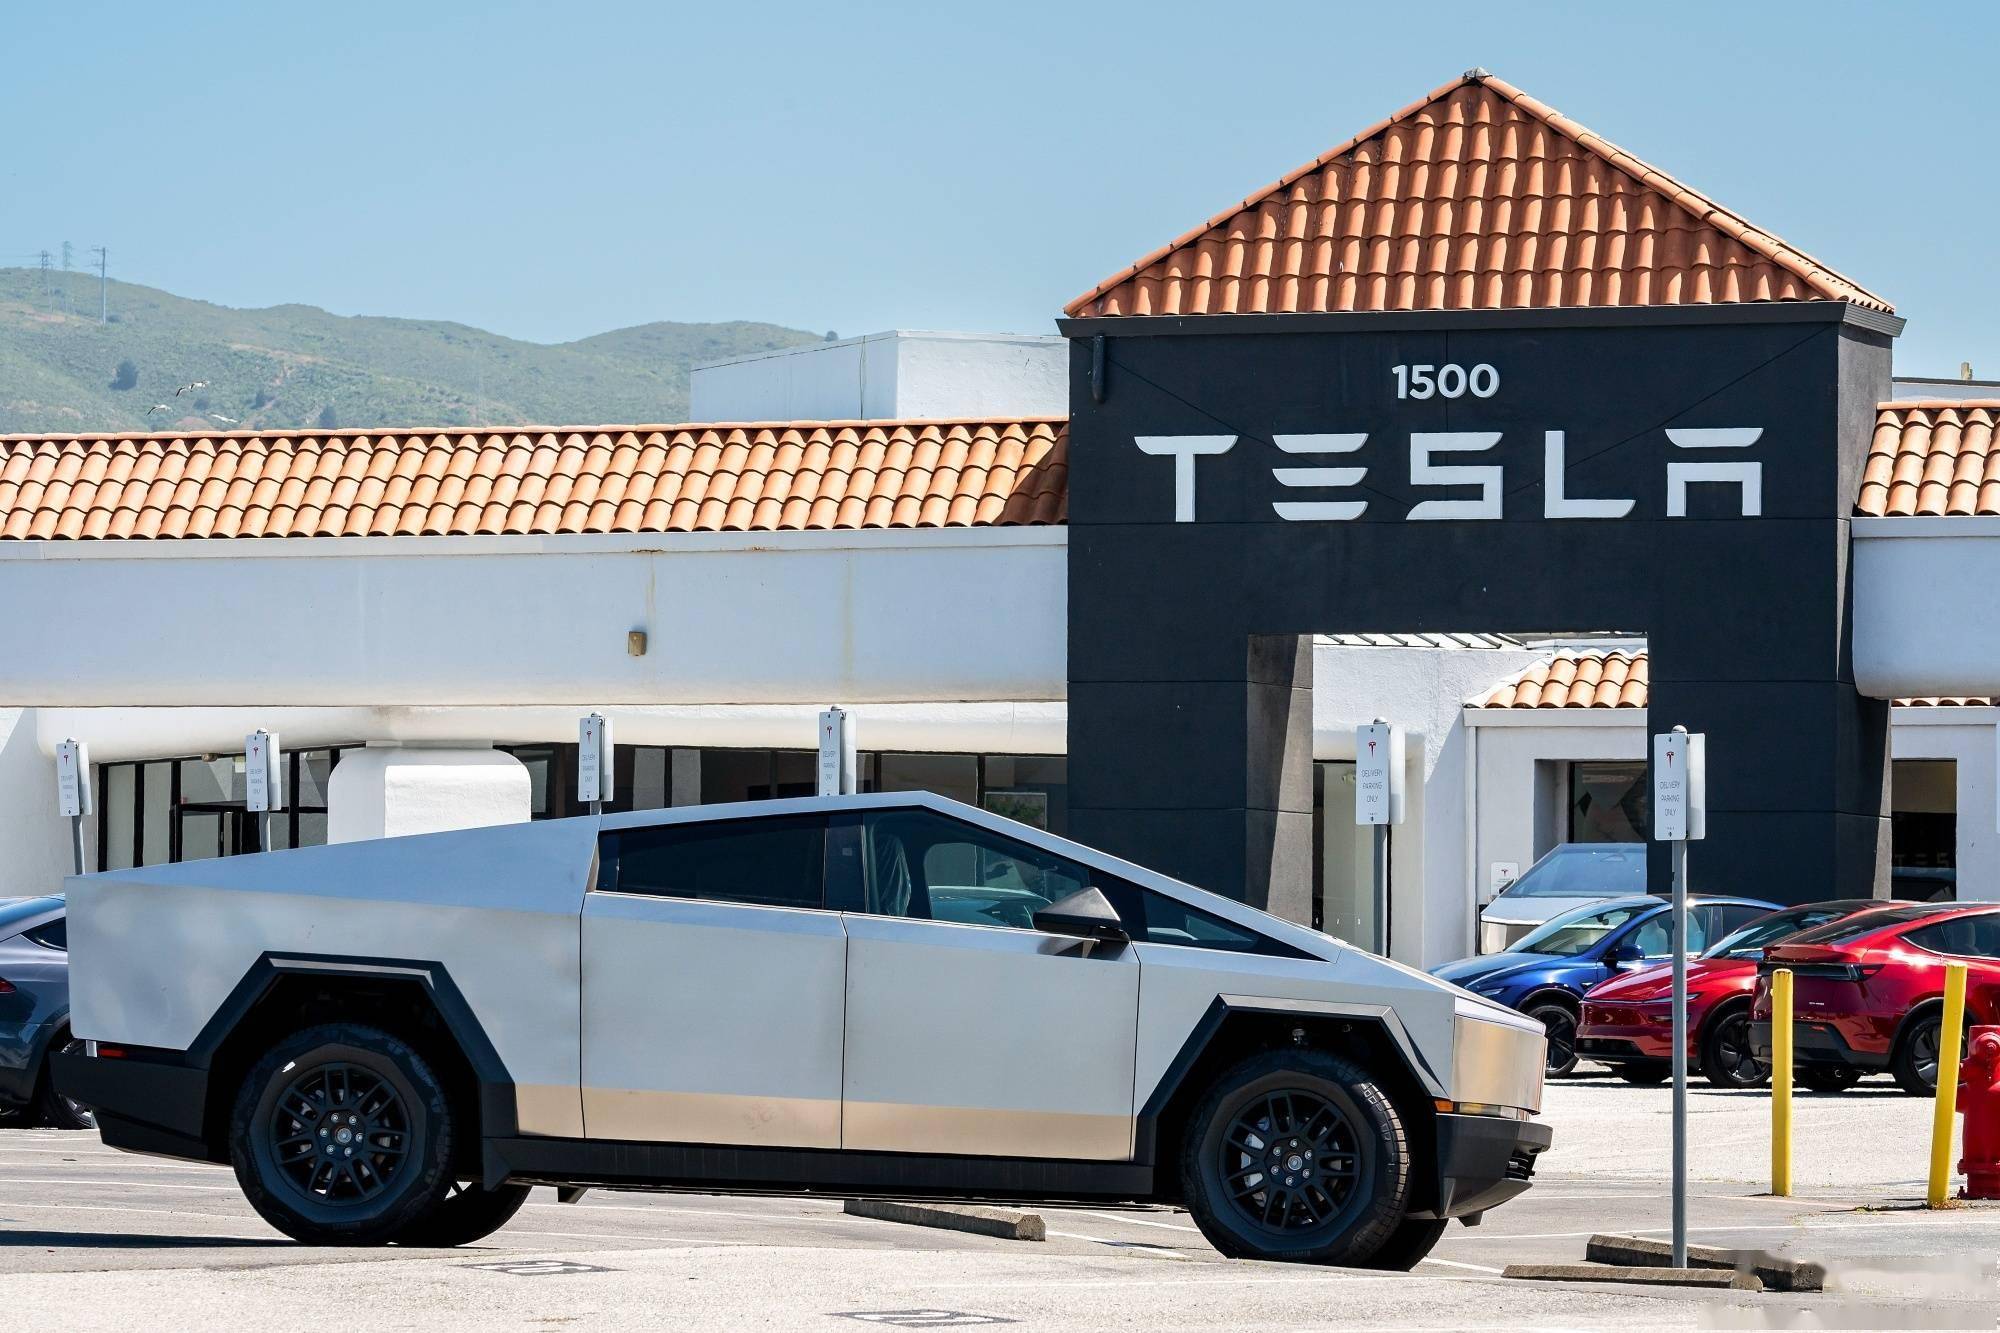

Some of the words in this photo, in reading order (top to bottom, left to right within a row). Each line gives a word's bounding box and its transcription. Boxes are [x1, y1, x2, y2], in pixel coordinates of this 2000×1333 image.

[1391, 363, 1500, 400] 1500
[1133, 427, 1764, 523] TESLA
[1361, 769, 1383, 778] DELIVERY
[1362, 782, 1383, 790] PARKING
[1659, 781, 1680, 790] DELIVERY
[1366, 794, 1379, 803] ONLY
[1661, 794, 1680, 803] PARKING
[1664, 808, 1677, 817] ONLY
